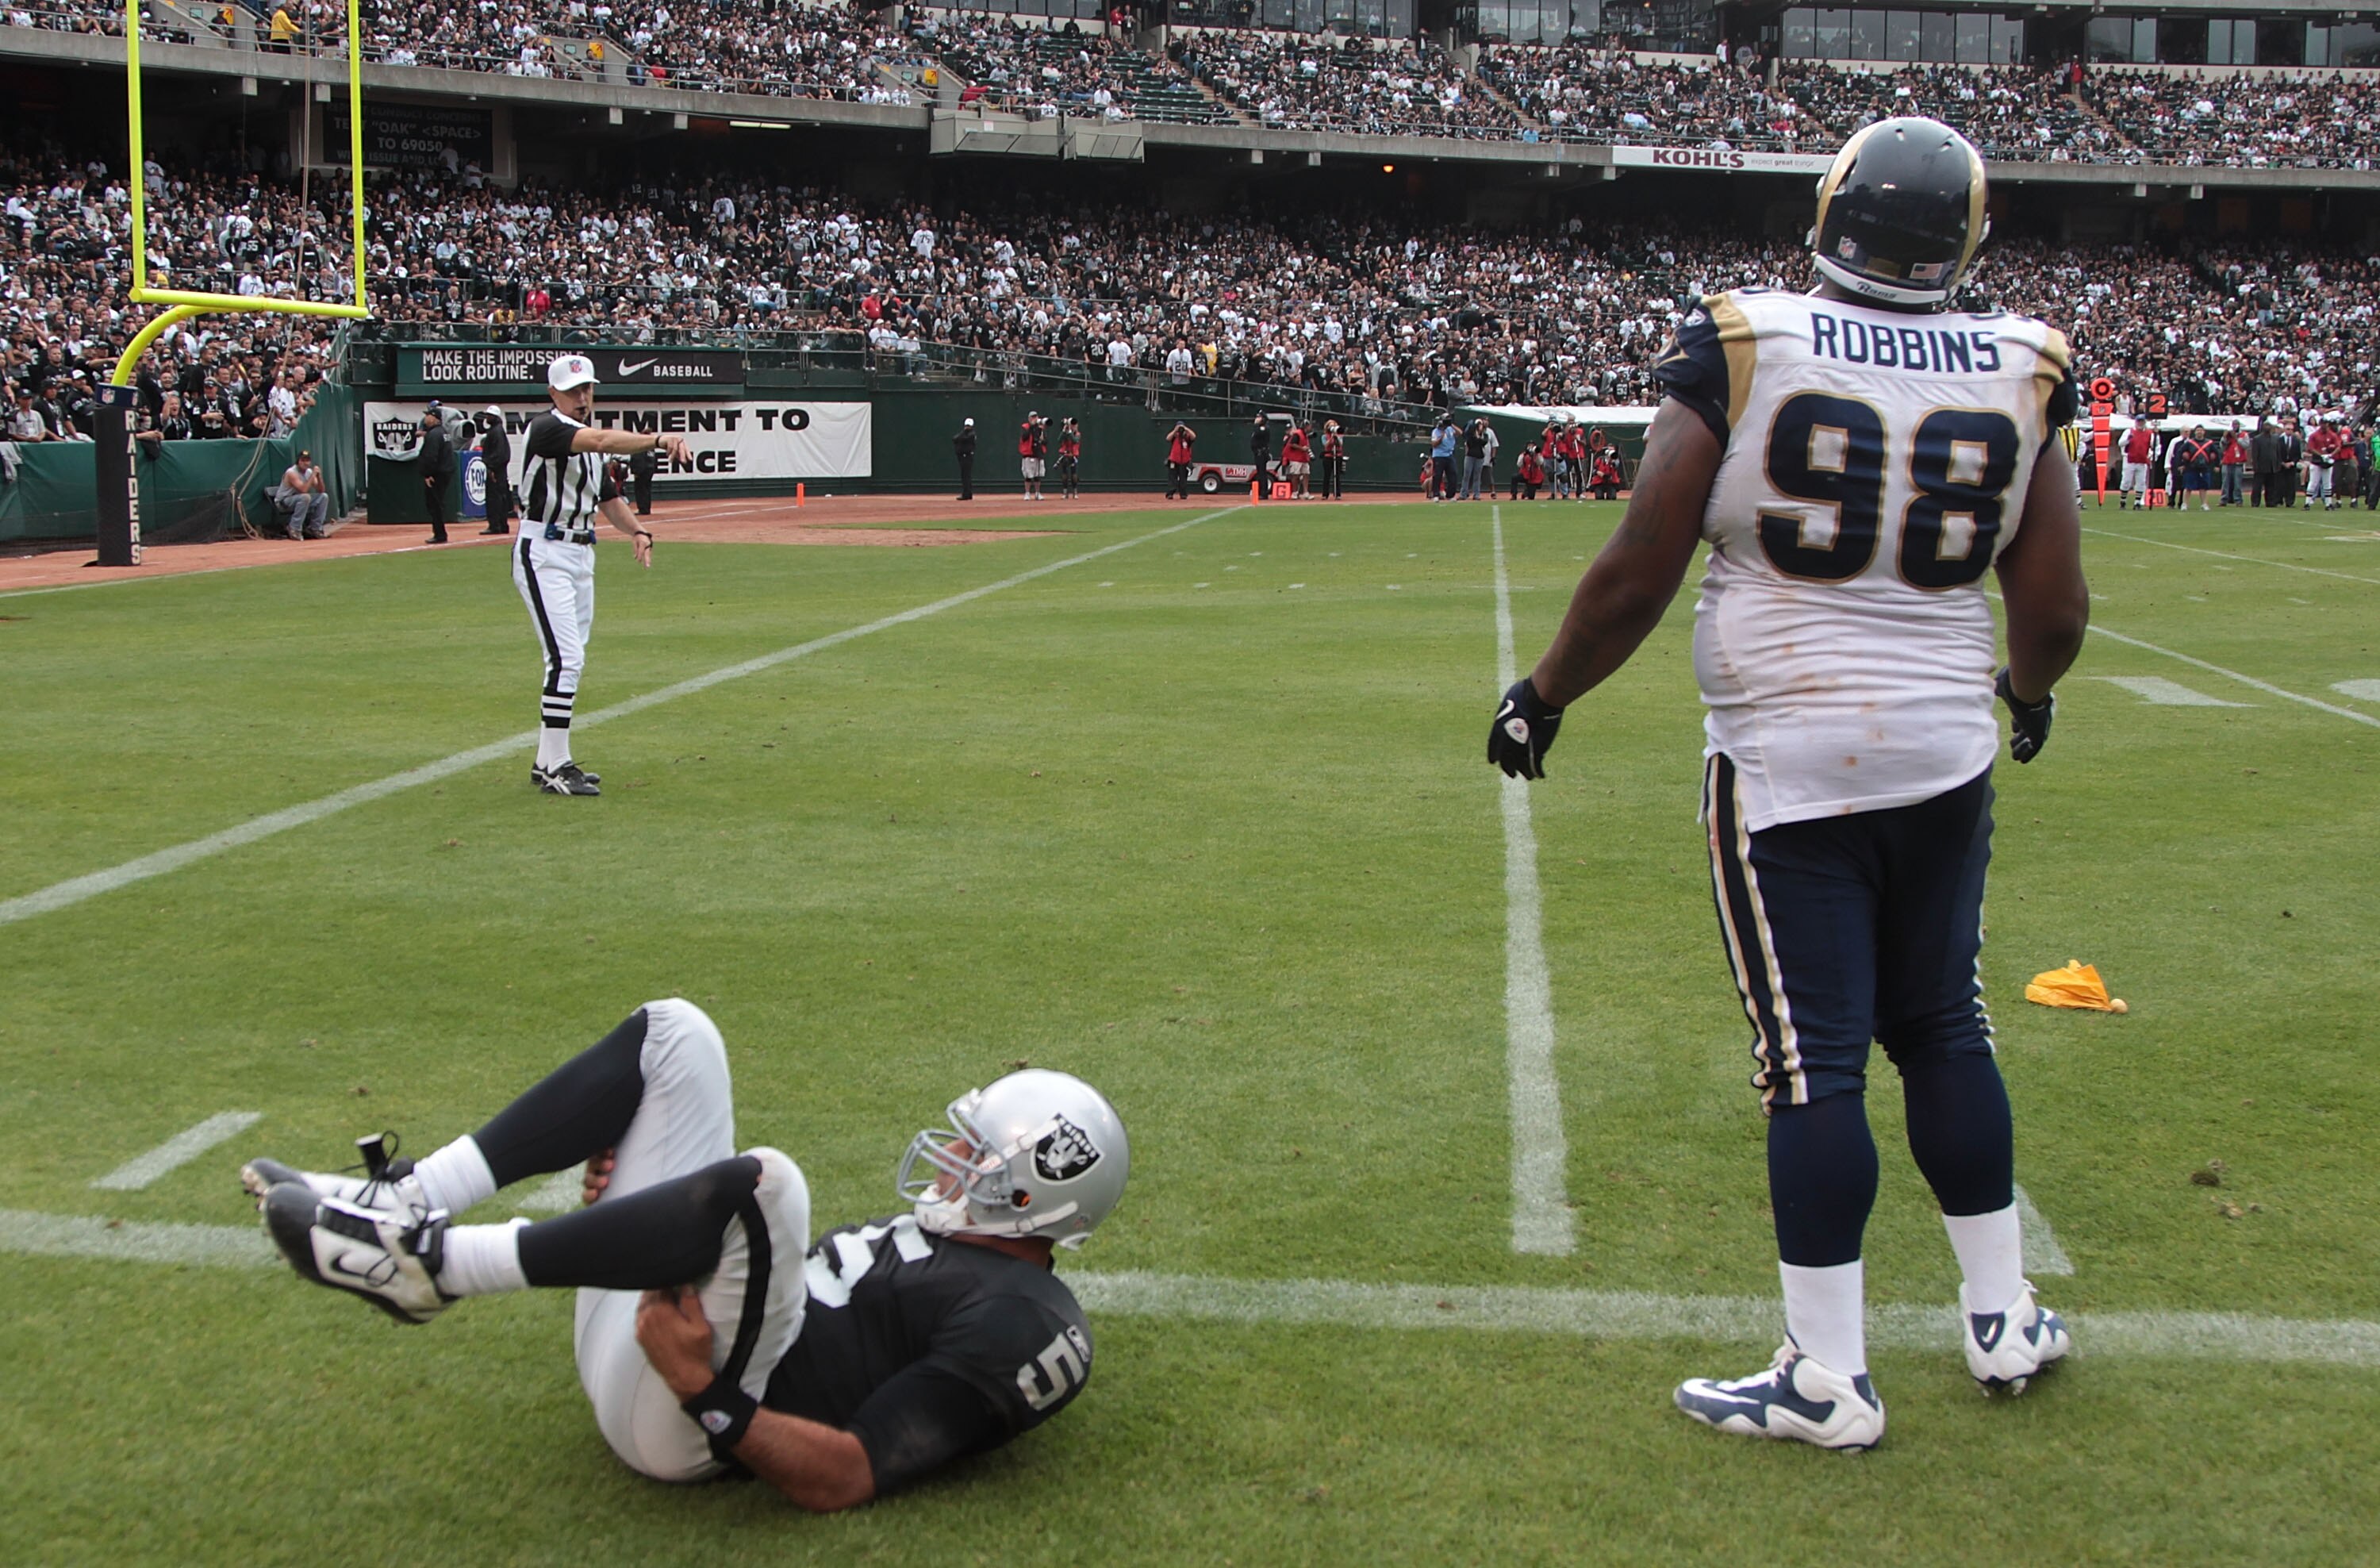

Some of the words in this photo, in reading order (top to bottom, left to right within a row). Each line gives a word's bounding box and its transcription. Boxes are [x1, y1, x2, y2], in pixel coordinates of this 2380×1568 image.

[377, 137, 397, 150] TO
[401, 139, 443, 152] 69050
[1652, 149, 1745, 168] KOHL'S
[1856, 280, 1898, 300] Rams
[1810, 312, 2002, 373] ROBBINS
[422, 350, 463, 365] MAKE
[474, 350, 495, 365] THE
[422, 364, 463, 381] LOOK
[466, 364, 534, 380] ROUTINE.
[653, 365, 713, 378] BASEBALL
[2149, 394, 2166, 413] 2
[376, 421, 413, 431] RAIDERS
[755, 409, 810, 431] TO
[125, 409, 141, 565] RAIDERS
[1276, 485, 1286, 498] G
[1756, 388, 2021, 592] 98
[1016, 1331, 1085, 1412] 5
